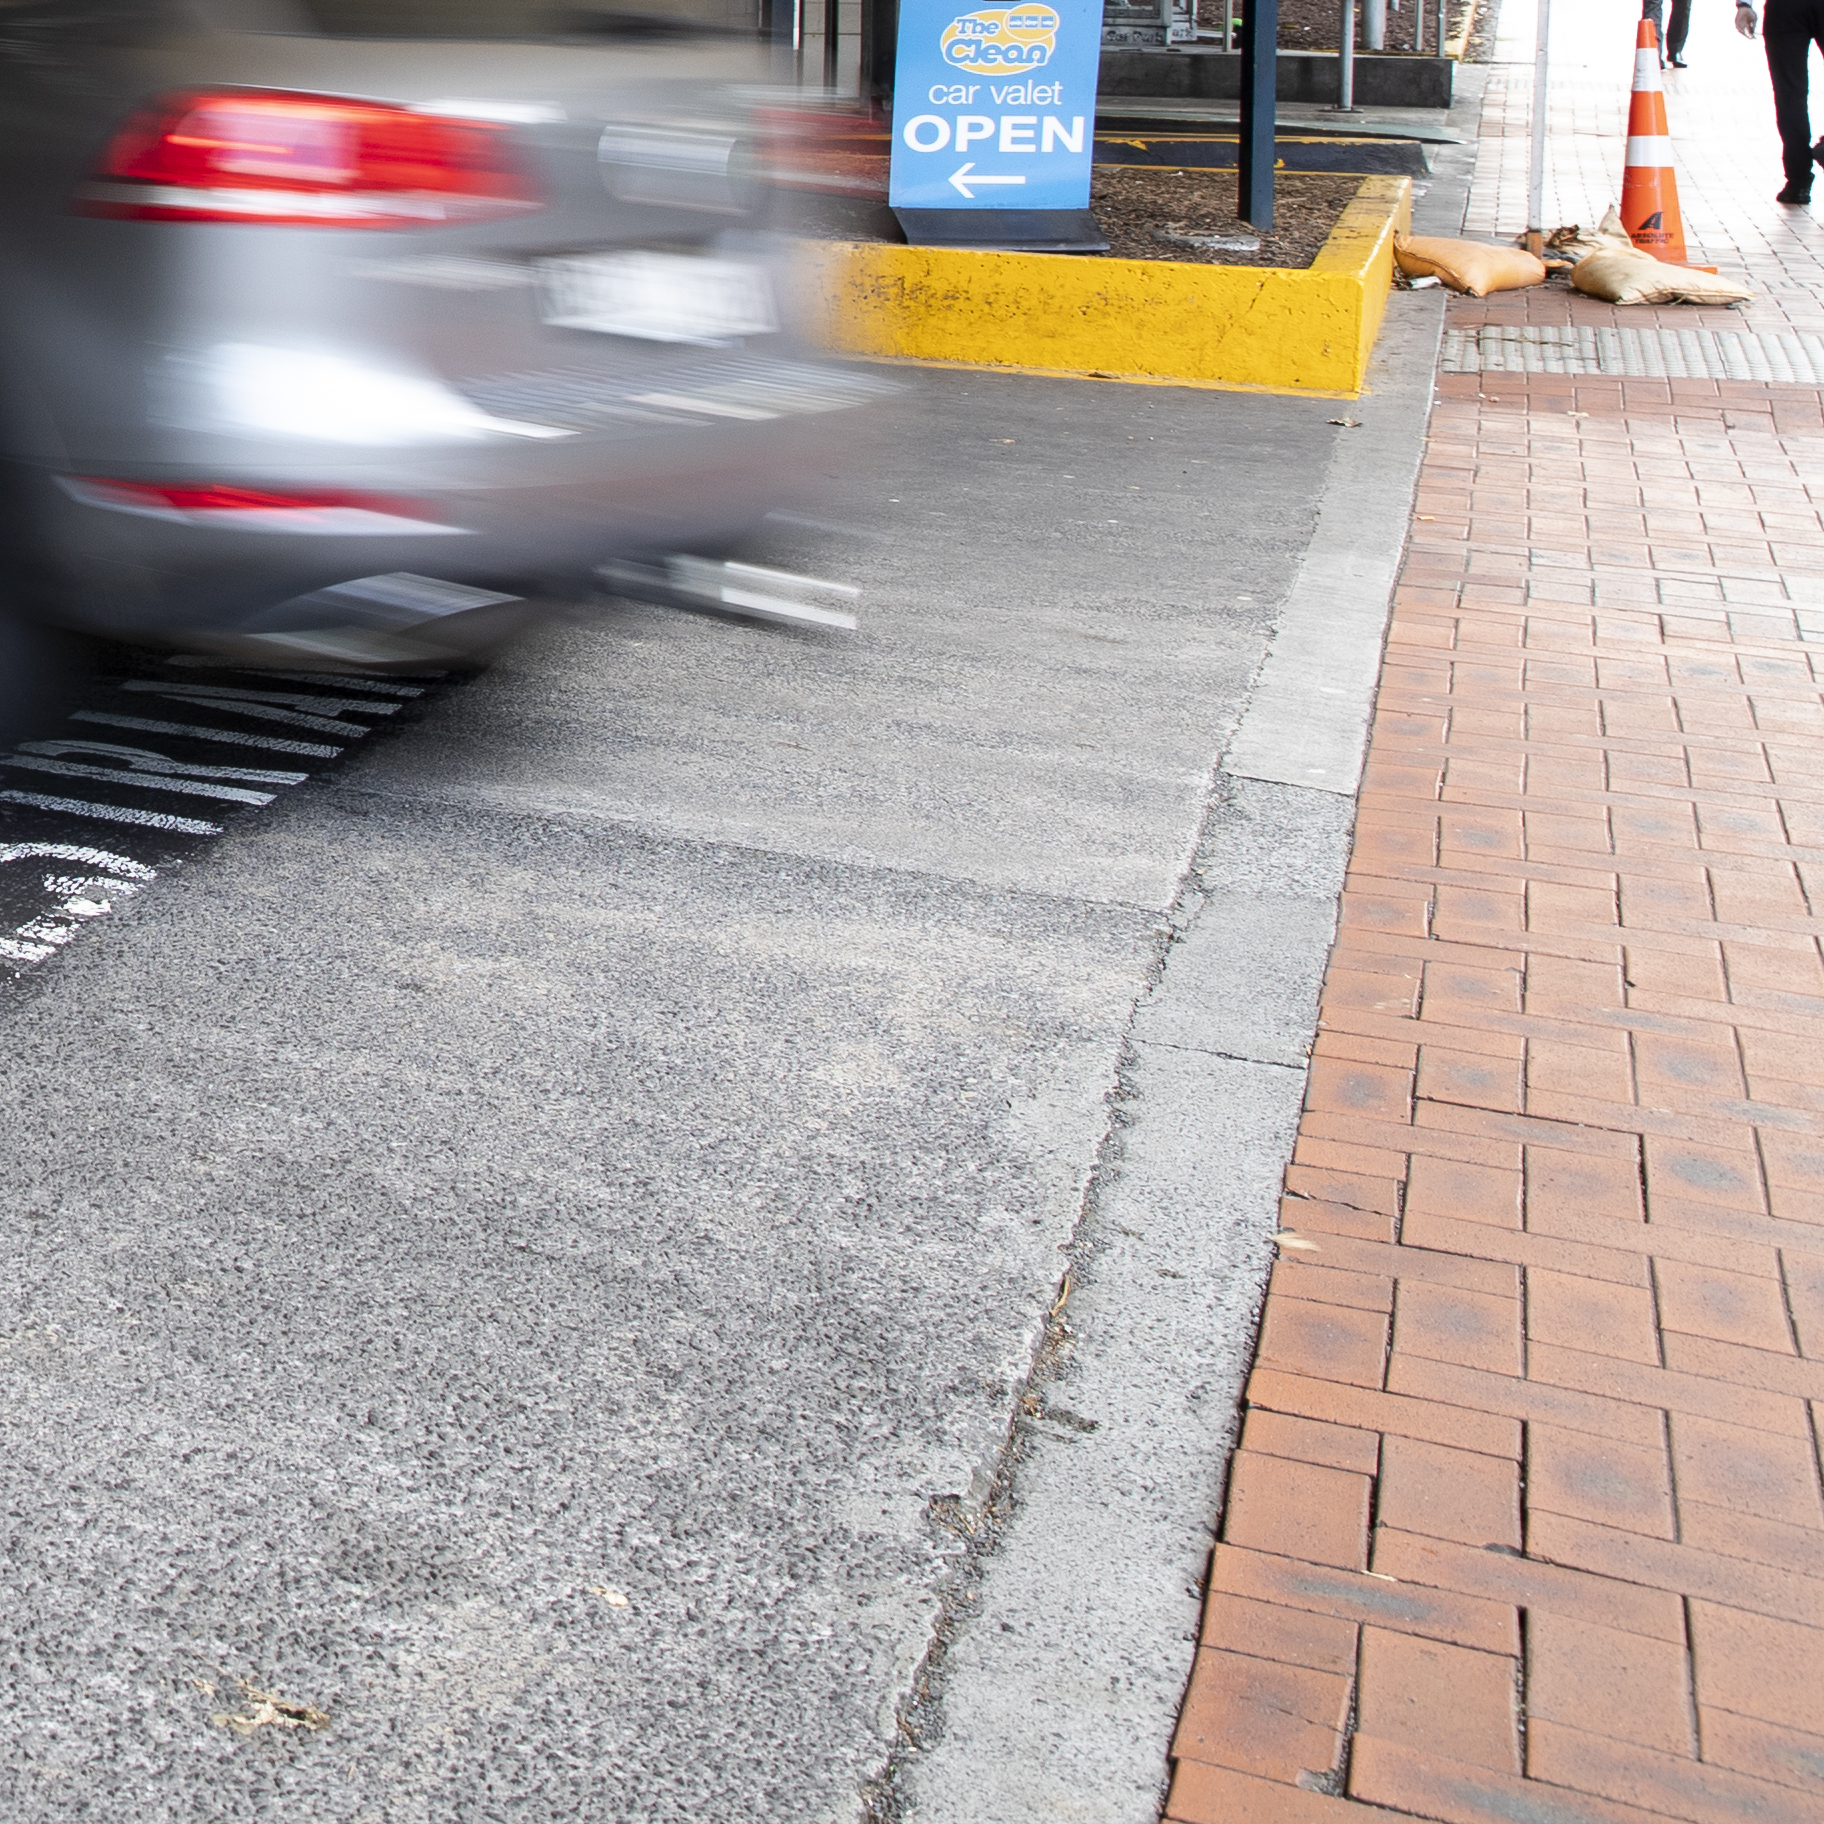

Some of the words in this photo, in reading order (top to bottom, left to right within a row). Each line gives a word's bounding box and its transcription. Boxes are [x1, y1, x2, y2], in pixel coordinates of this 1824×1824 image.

[955, 17, 1000, 36] The
[943, 38, 1049, 66] Clean
[928, 84, 981, 105] car
[989, 79, 1064, 106] valet
[903, 114, 1085, 153] OPEN
